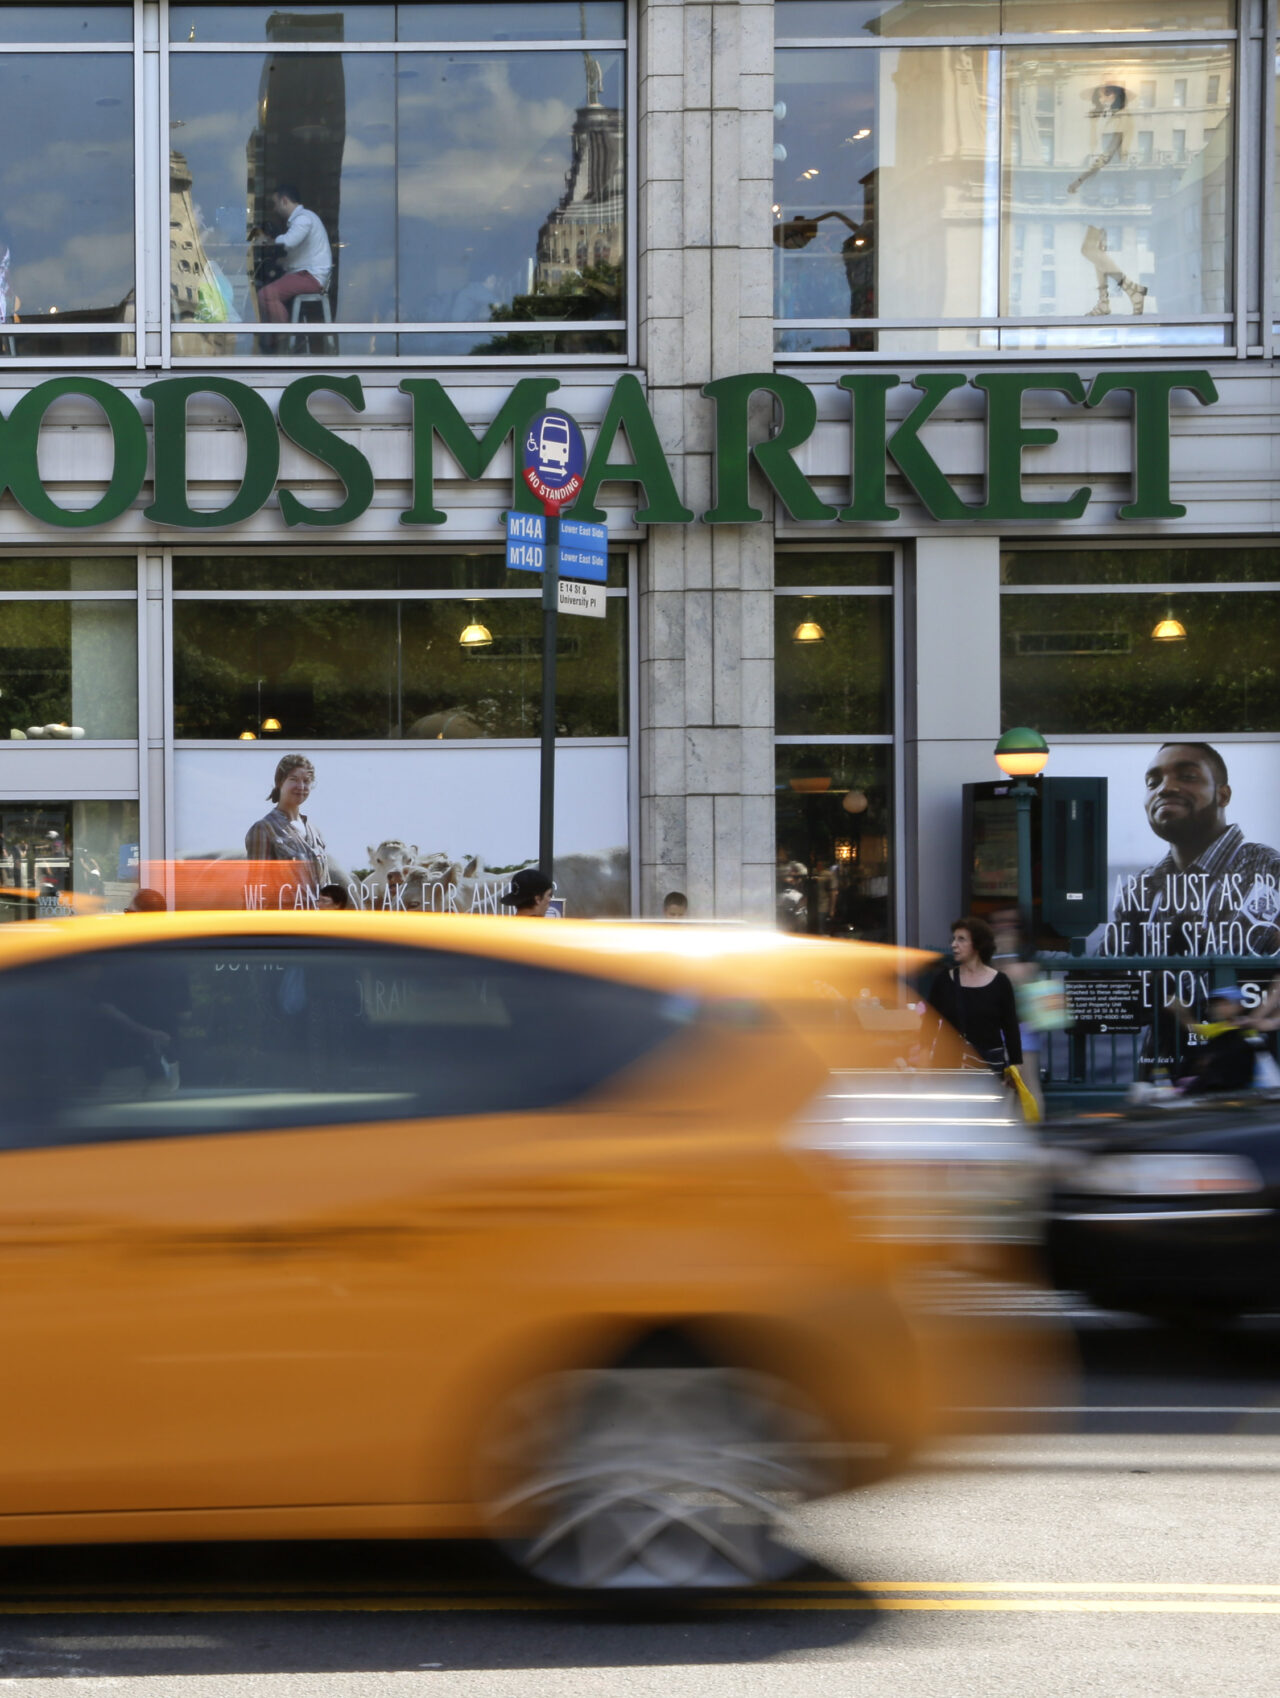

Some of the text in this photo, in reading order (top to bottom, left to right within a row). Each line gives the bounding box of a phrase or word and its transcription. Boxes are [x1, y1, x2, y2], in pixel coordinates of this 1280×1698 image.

[398, 369, 1220, 526] MARKET
[528, 471, 579, 500] NO STANDING
[510, 516, 542, 539] M14A
[561, 523, 604, 539] Lower East Side
[510, 545, 543, 568] M14D
[561, 551, 604, 567] Lower East Side
[560, 583, 564, 593] E
[566, 584, 573, 594] 14
[575, 585, 581, 595] St
[560, 594, 589, 608] University
[244, 884, 267, 911] WE
[347, 883, 409, 912] SPEAK
[422, 883, 459, 914] FOR
[1112, 873, 1151, 912] ARE
[1158, 873, 1210, 912] JUST
[1219, 873, 1244, 912] AS
[1104, 922, 1131, 957] OF
[1139, 922, 1173, 957] THE
